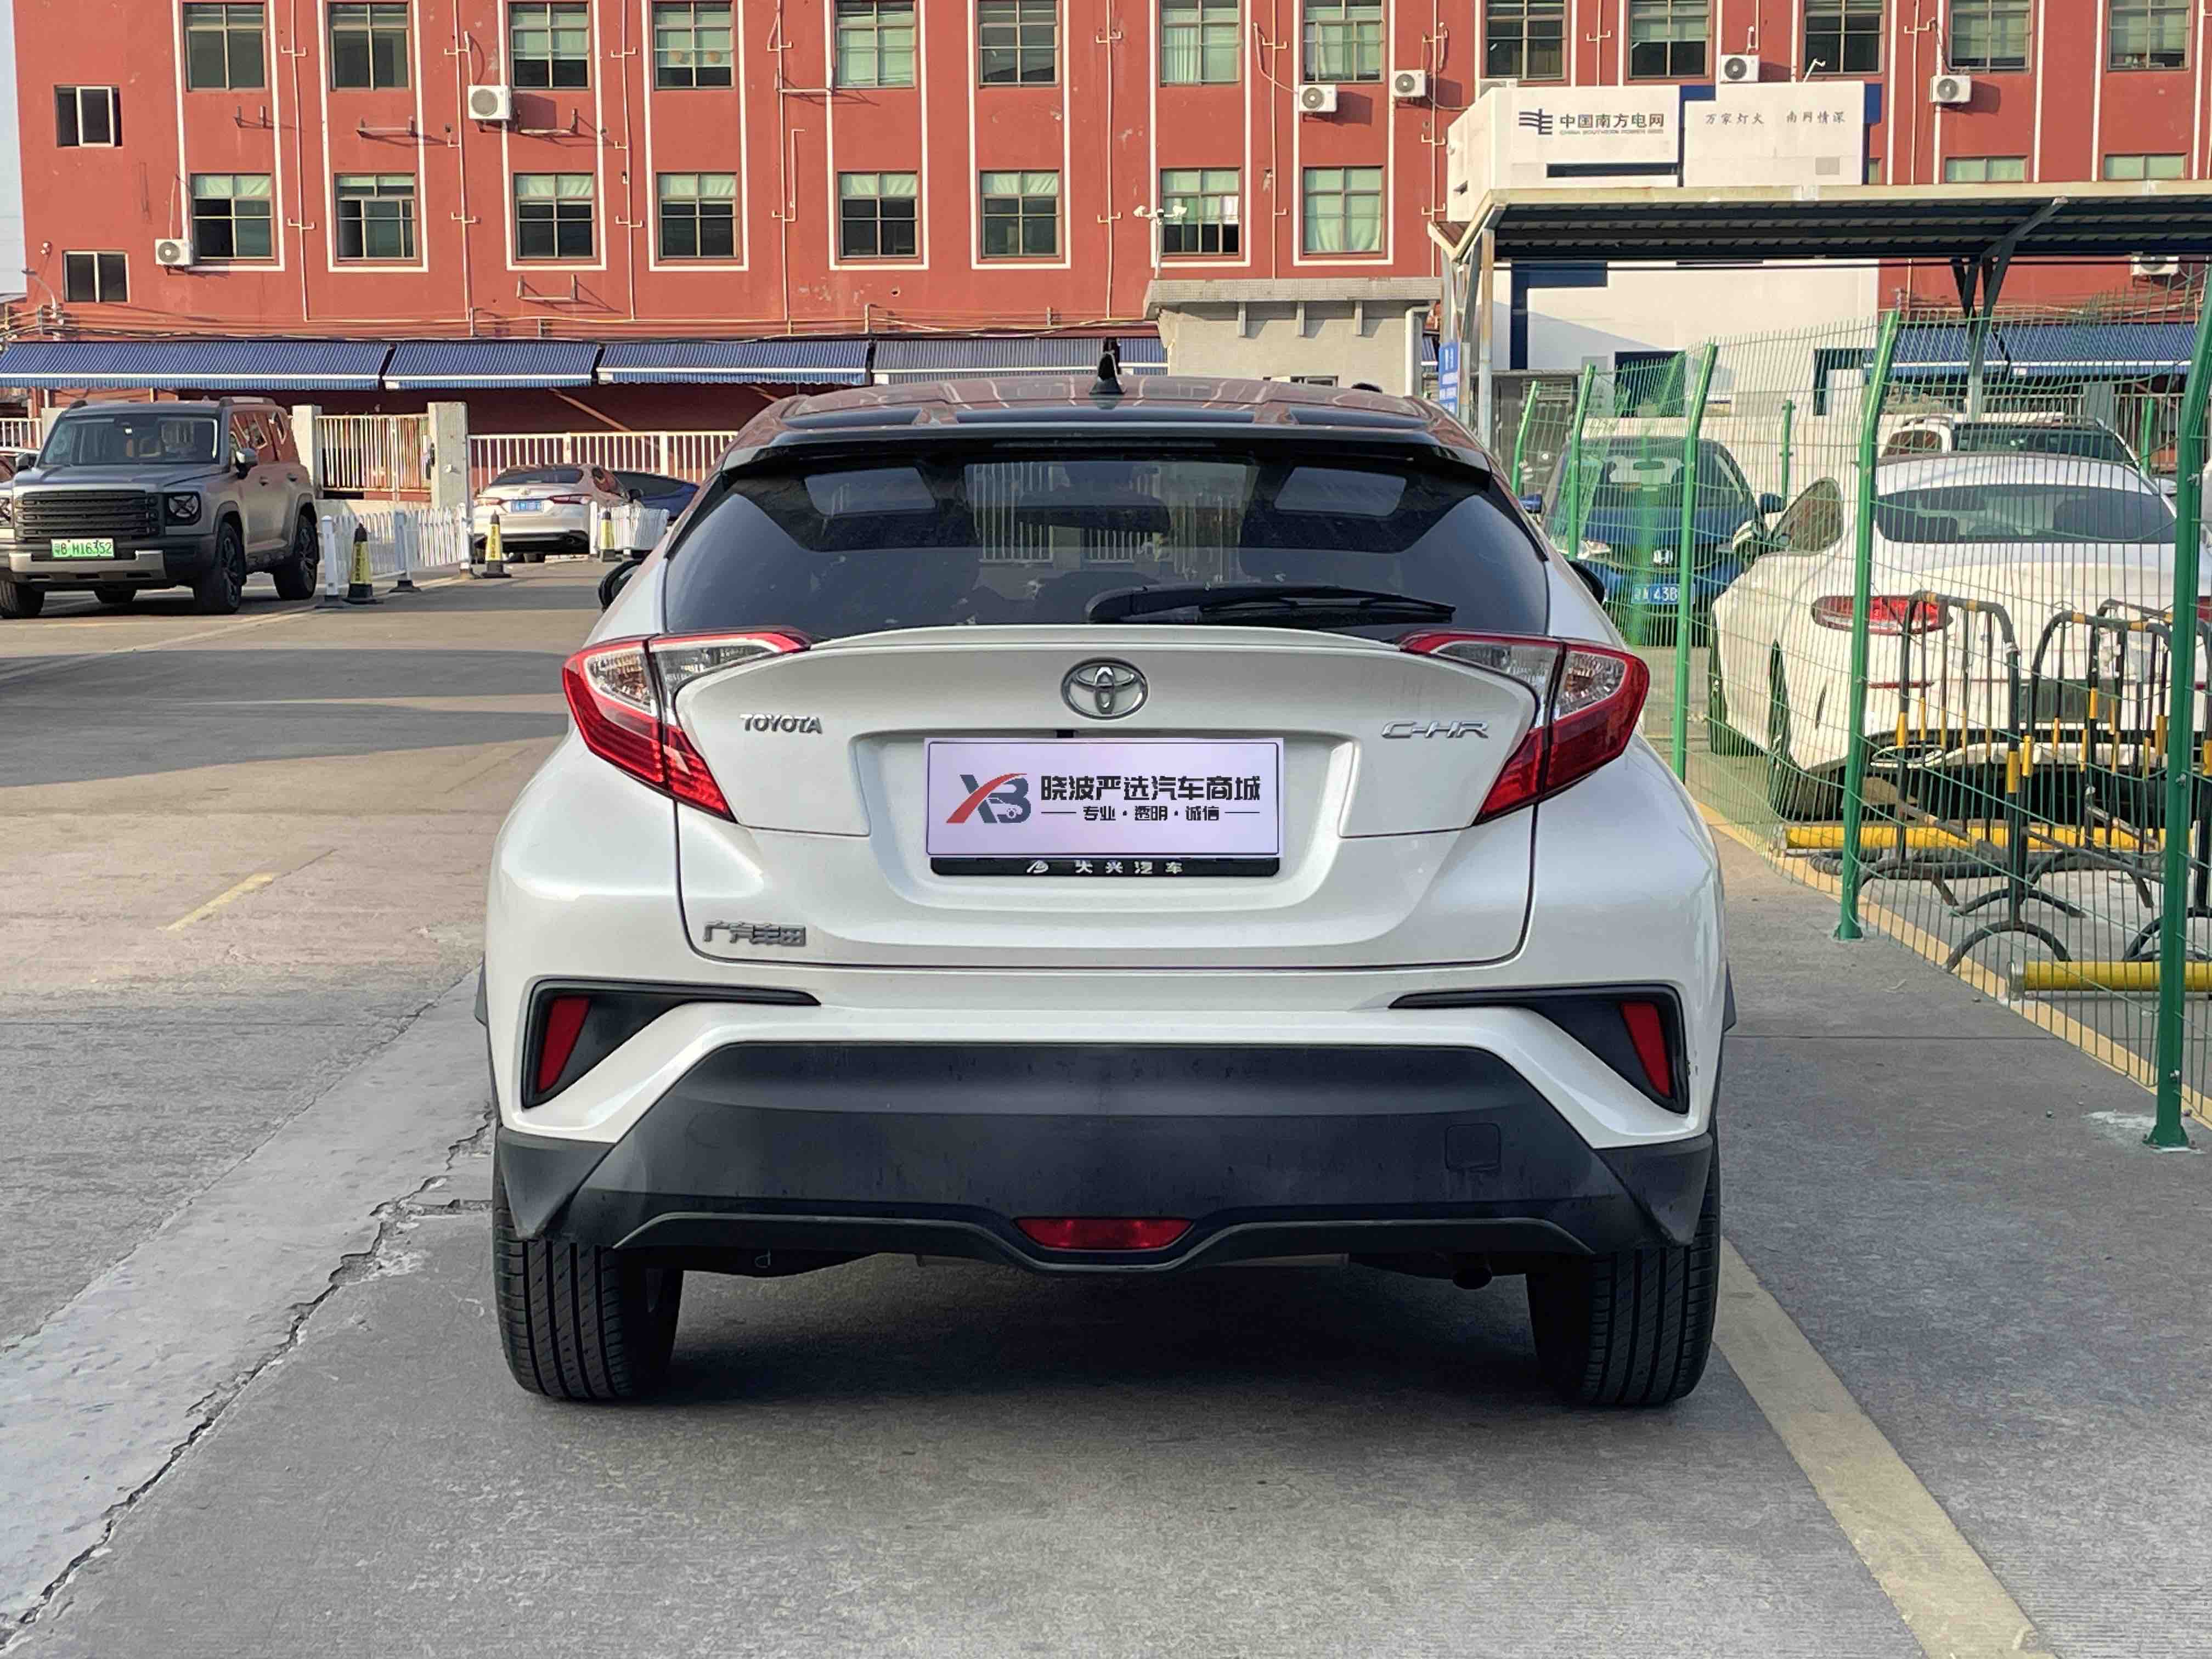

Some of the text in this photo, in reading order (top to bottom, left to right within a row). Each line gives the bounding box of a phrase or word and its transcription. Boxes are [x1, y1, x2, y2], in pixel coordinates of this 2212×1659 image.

[1560, 112, 1664, 128] 中国南方电网
[1705, 110, 1845, 125] 万家灯火 南网情深
[740, 714, 822, 734] TOYOTA
[1381, 720, 1488, 738] C-HR
